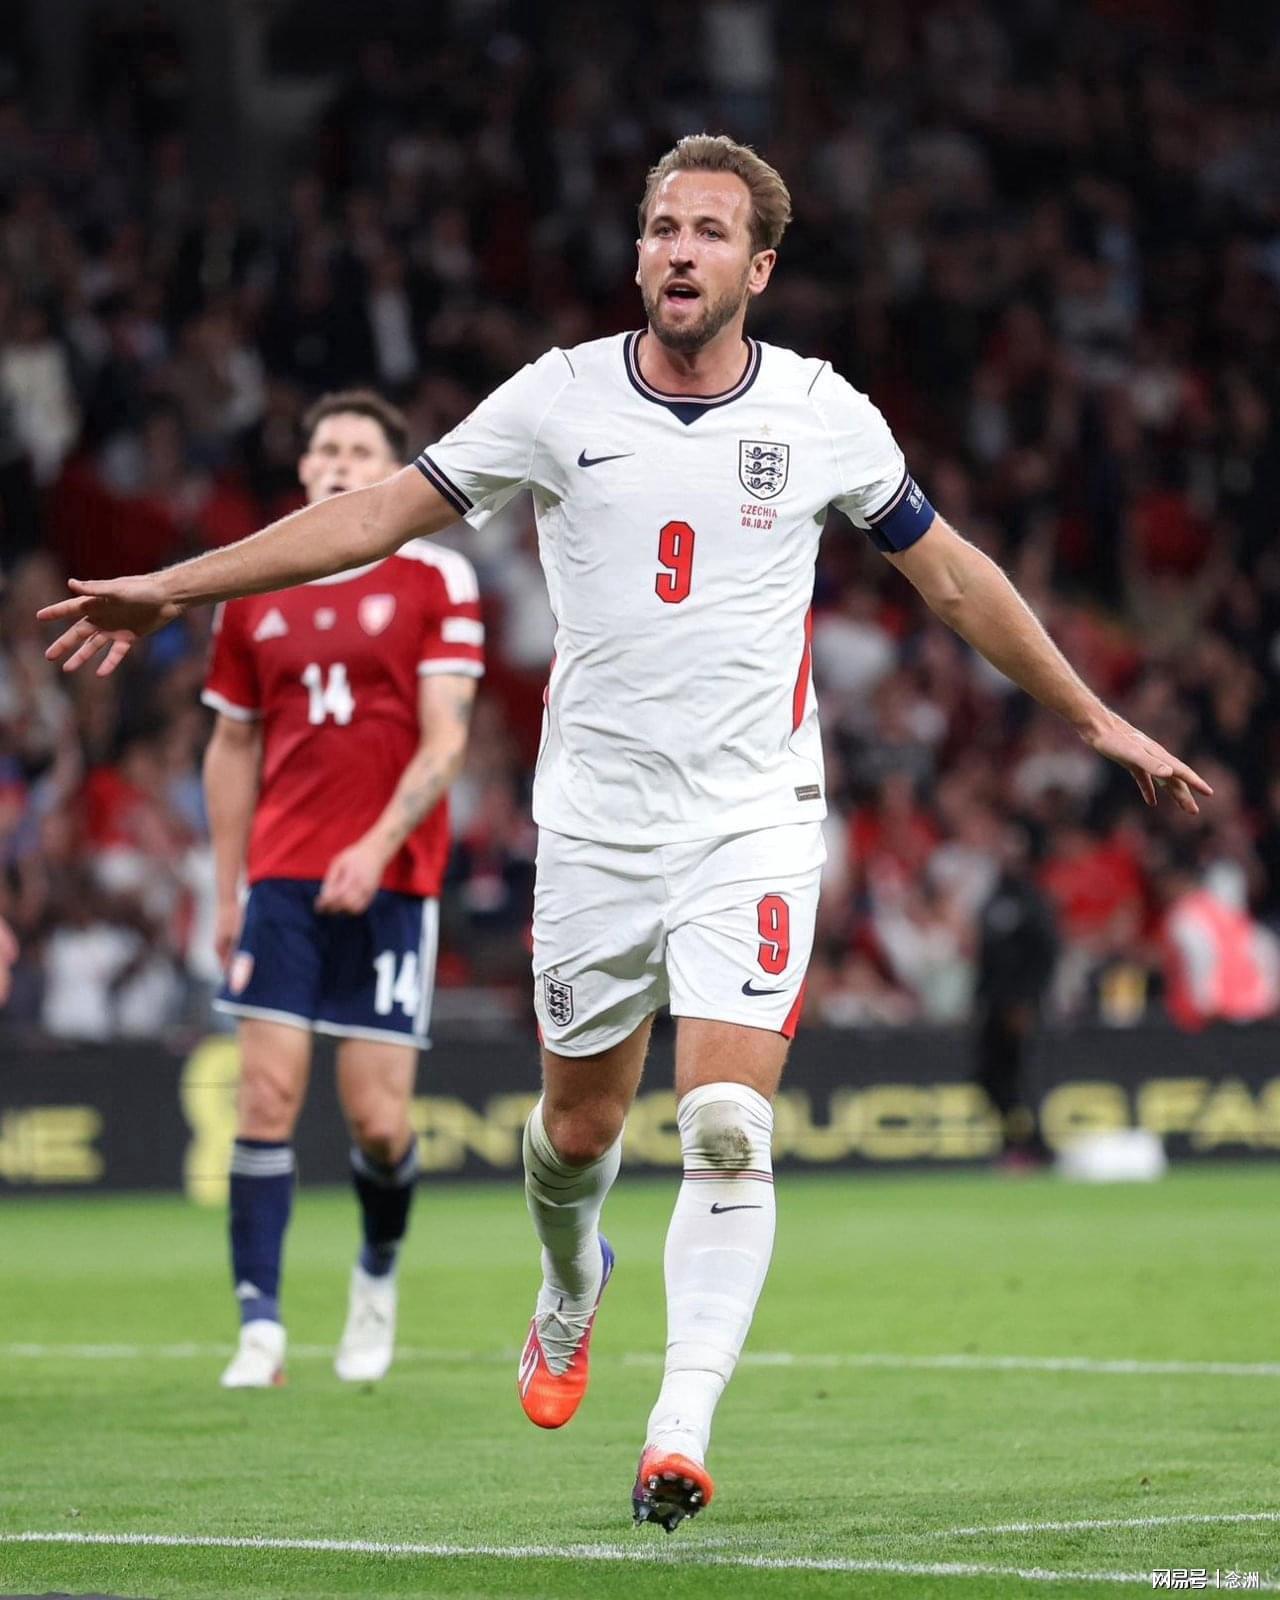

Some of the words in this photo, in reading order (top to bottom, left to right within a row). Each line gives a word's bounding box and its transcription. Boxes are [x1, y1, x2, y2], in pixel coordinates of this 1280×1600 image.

[740, 504, 778, 518] CZECHIA
[655, 521, 695, 603] 9
[302, 663, 355, 725] 14
[757, 894, 790, 975] 9
[374, 950, 421, 1017] 14
